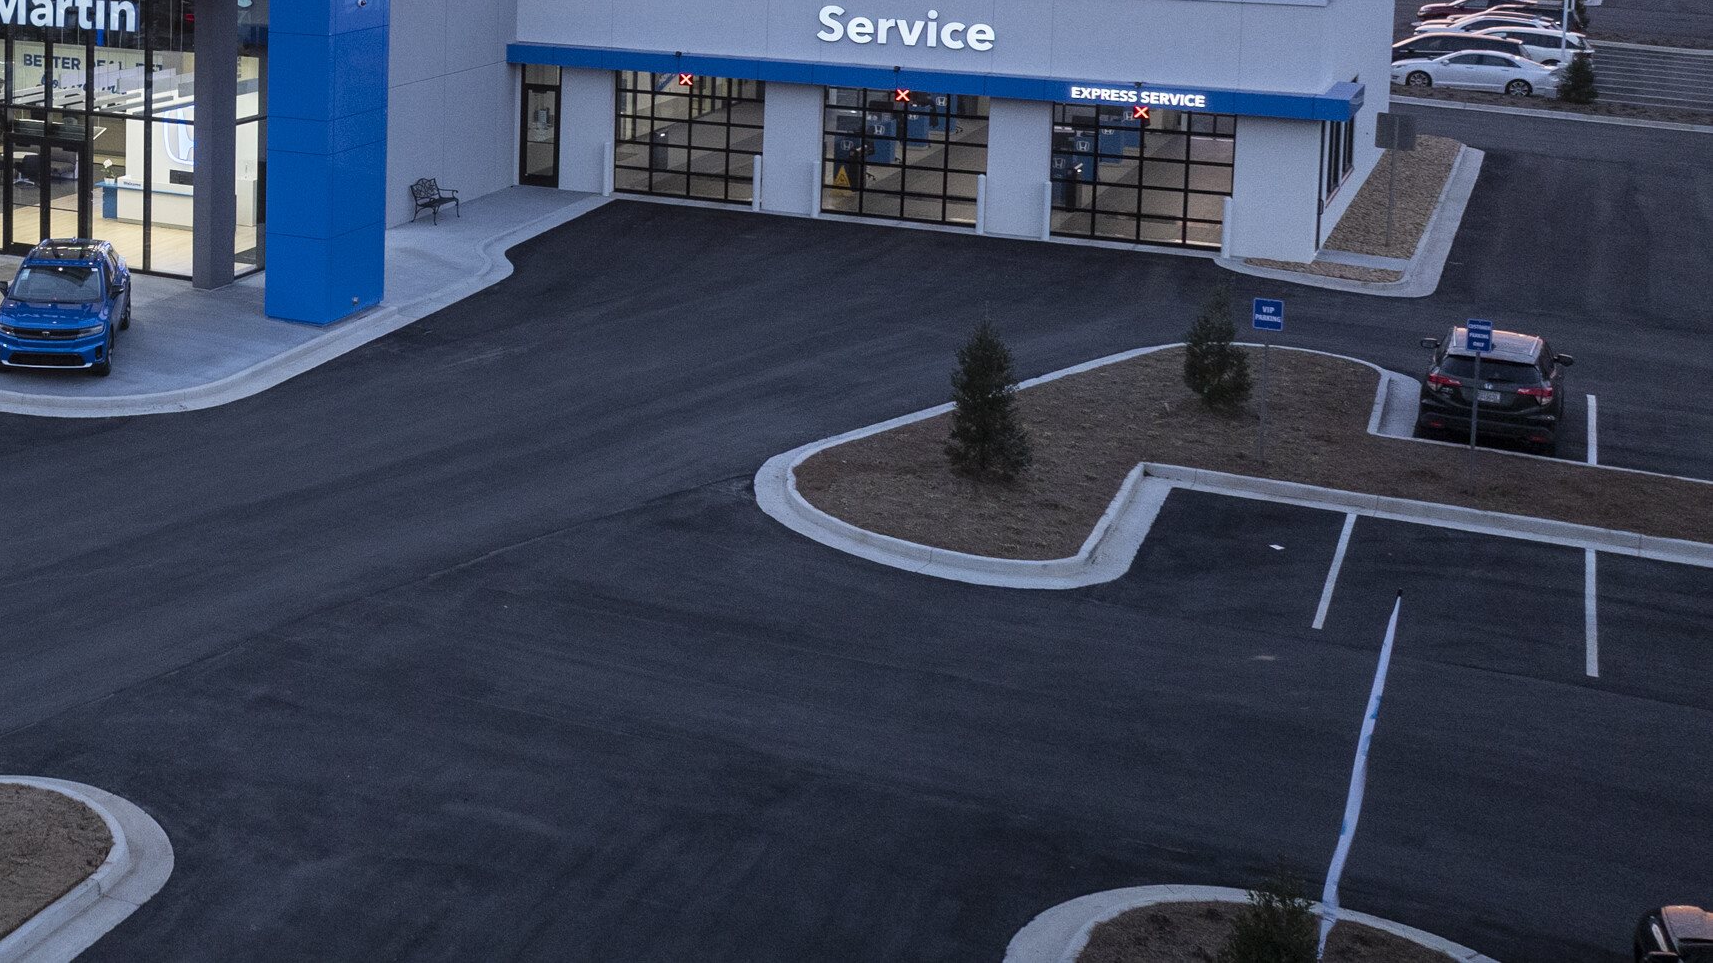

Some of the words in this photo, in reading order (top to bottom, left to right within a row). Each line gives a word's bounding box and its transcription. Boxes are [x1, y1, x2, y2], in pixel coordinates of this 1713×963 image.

[816, 4, 995, 51] Service
[23, 53, 81, 70] BETER
[1071, 86, 1139, 103] EXPRESS
[1140, 91, 1206, 107] SERVICE
[1261, 305, 1275, 314] VIP
[1254, 313, 1282, 323] PARKING
[1468, 332, 1489, 340] PARKING
